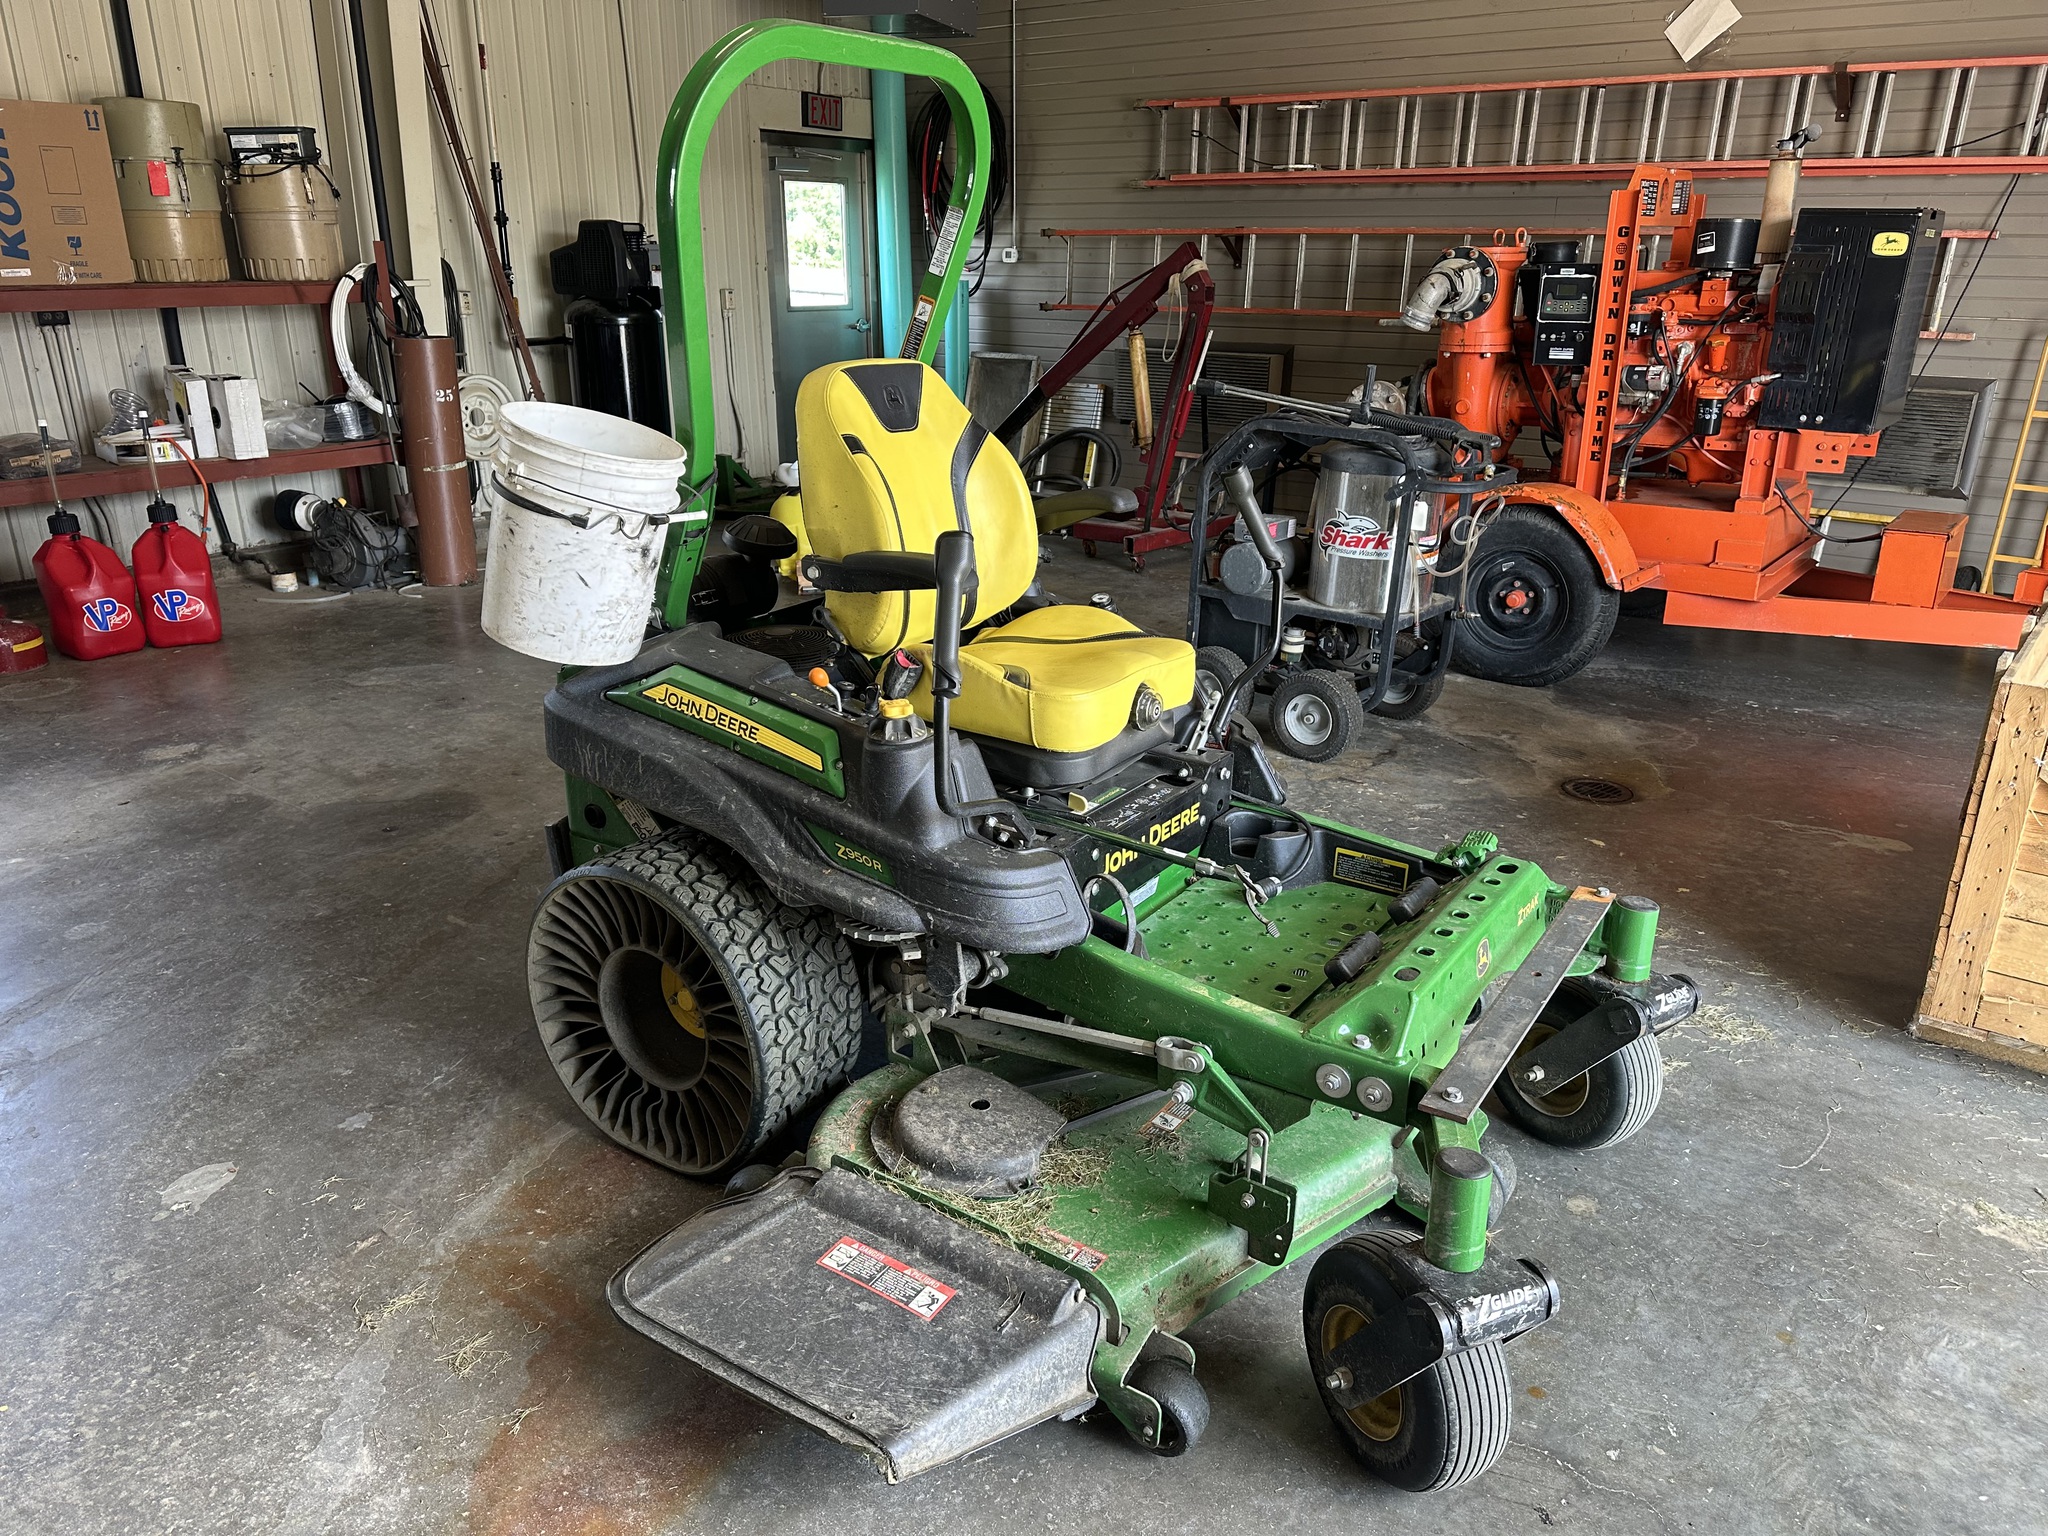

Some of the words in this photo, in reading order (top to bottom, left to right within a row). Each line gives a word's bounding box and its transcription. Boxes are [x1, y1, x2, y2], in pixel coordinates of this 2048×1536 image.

[811, 96, 840, 127] EXIT
[1590, 390, 1609, 462] PRIME
[1321, 526, 1393, 550] Shark
[1330, 546, 1357, 556] Pressure
[1358, 550, 1389, 558] Washers
[83, 598, 118, 632] VP
[109, 611, 129, 627] Racing
[152, 589, 188, 622] VP
[178, 603, 203, 618] Racing
[658, 687, 702, 718] JOHN
[704, 704, 760, 742] DEERE
[1150, 801, 1201, 846] DEERE
[860, 1245, 886, 1261] DANGER
[911, 1271, 940, 1289] PELIGRO
